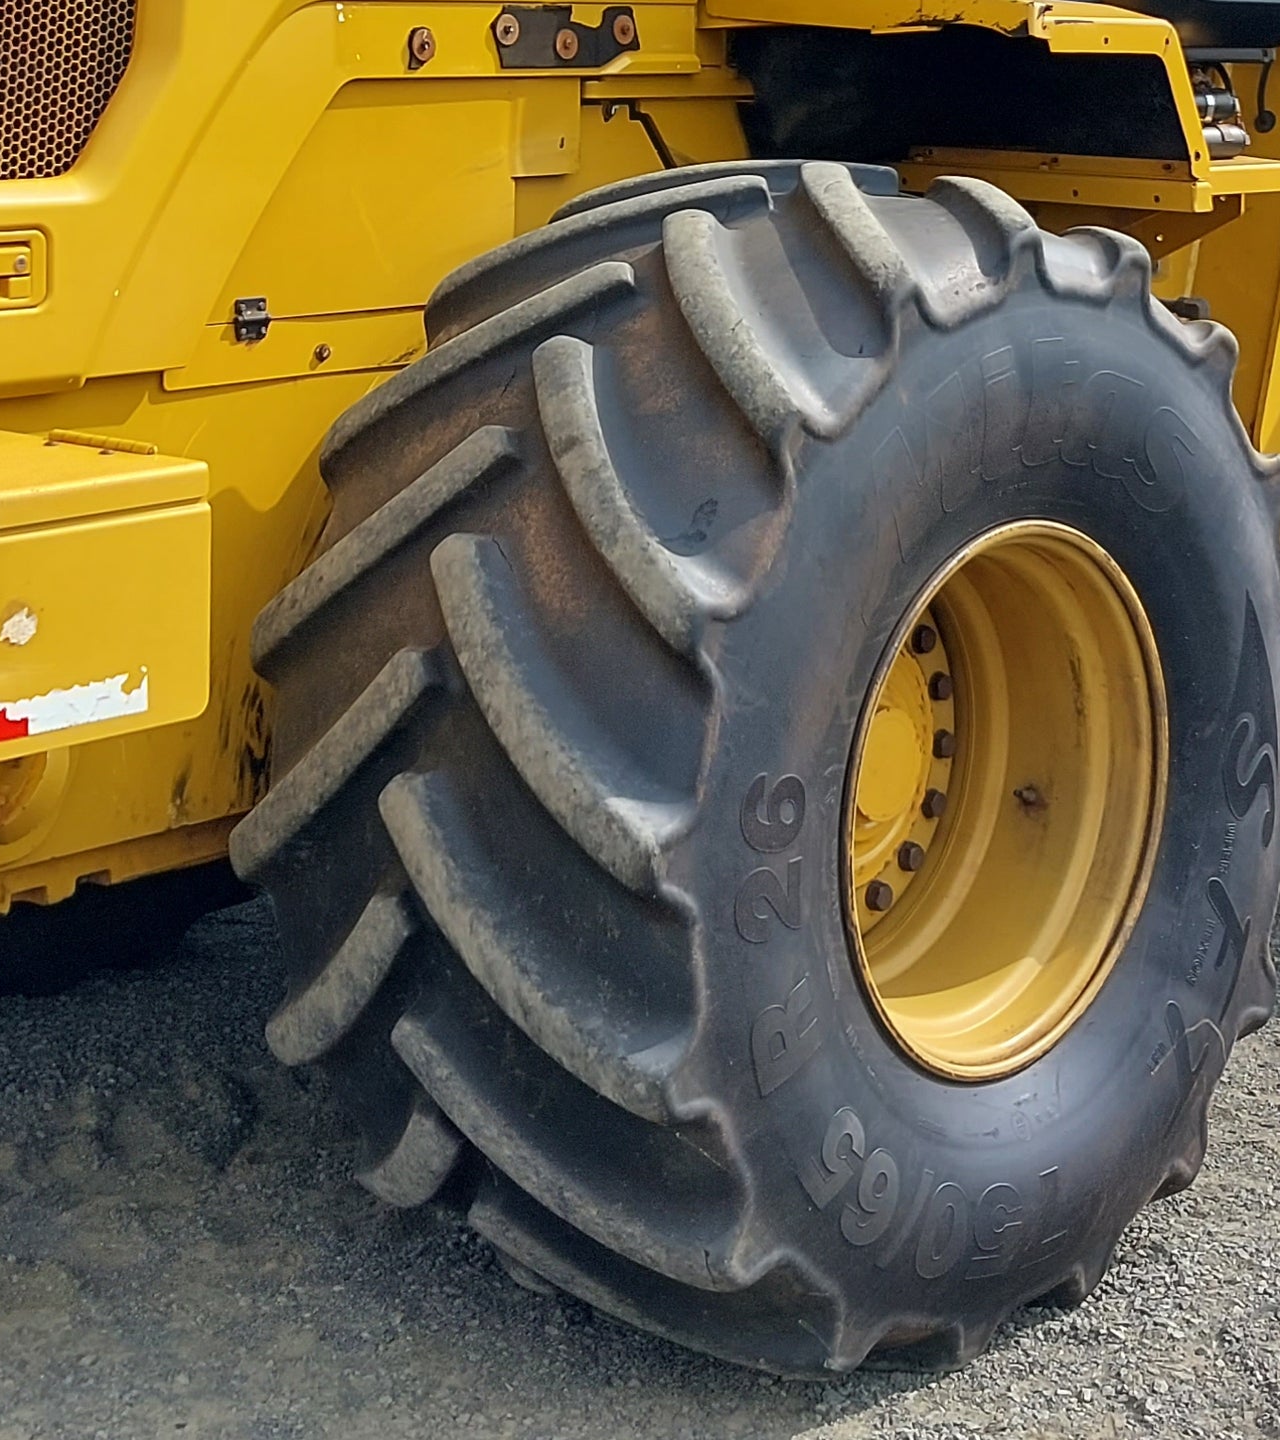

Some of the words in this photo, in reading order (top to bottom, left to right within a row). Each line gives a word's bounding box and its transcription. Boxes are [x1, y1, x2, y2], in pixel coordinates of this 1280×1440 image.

[733, 771, 806, 945] 26
[750, 971, 822, 1098] R
[797, 1105, 1068, 1280] 750/65
